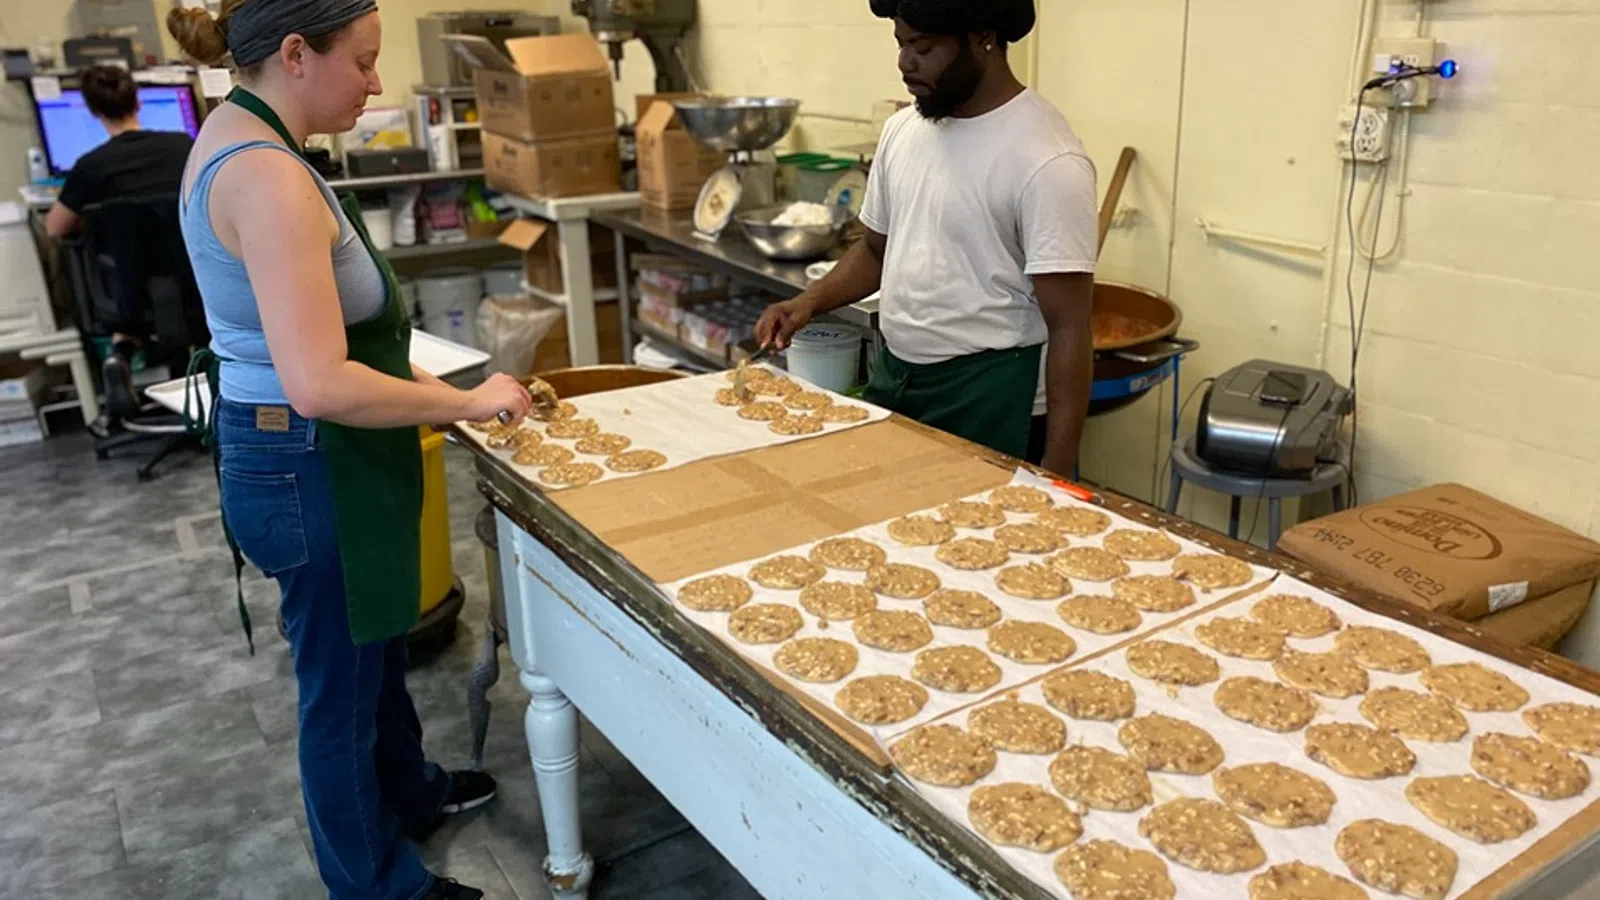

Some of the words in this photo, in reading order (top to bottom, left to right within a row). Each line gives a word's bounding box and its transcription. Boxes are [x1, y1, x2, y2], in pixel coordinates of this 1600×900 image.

[1372, 516, 1463, 552] Domino
[1352, 547, 1393, 570] 787
[1393, 565, 1446, 596] 6230
